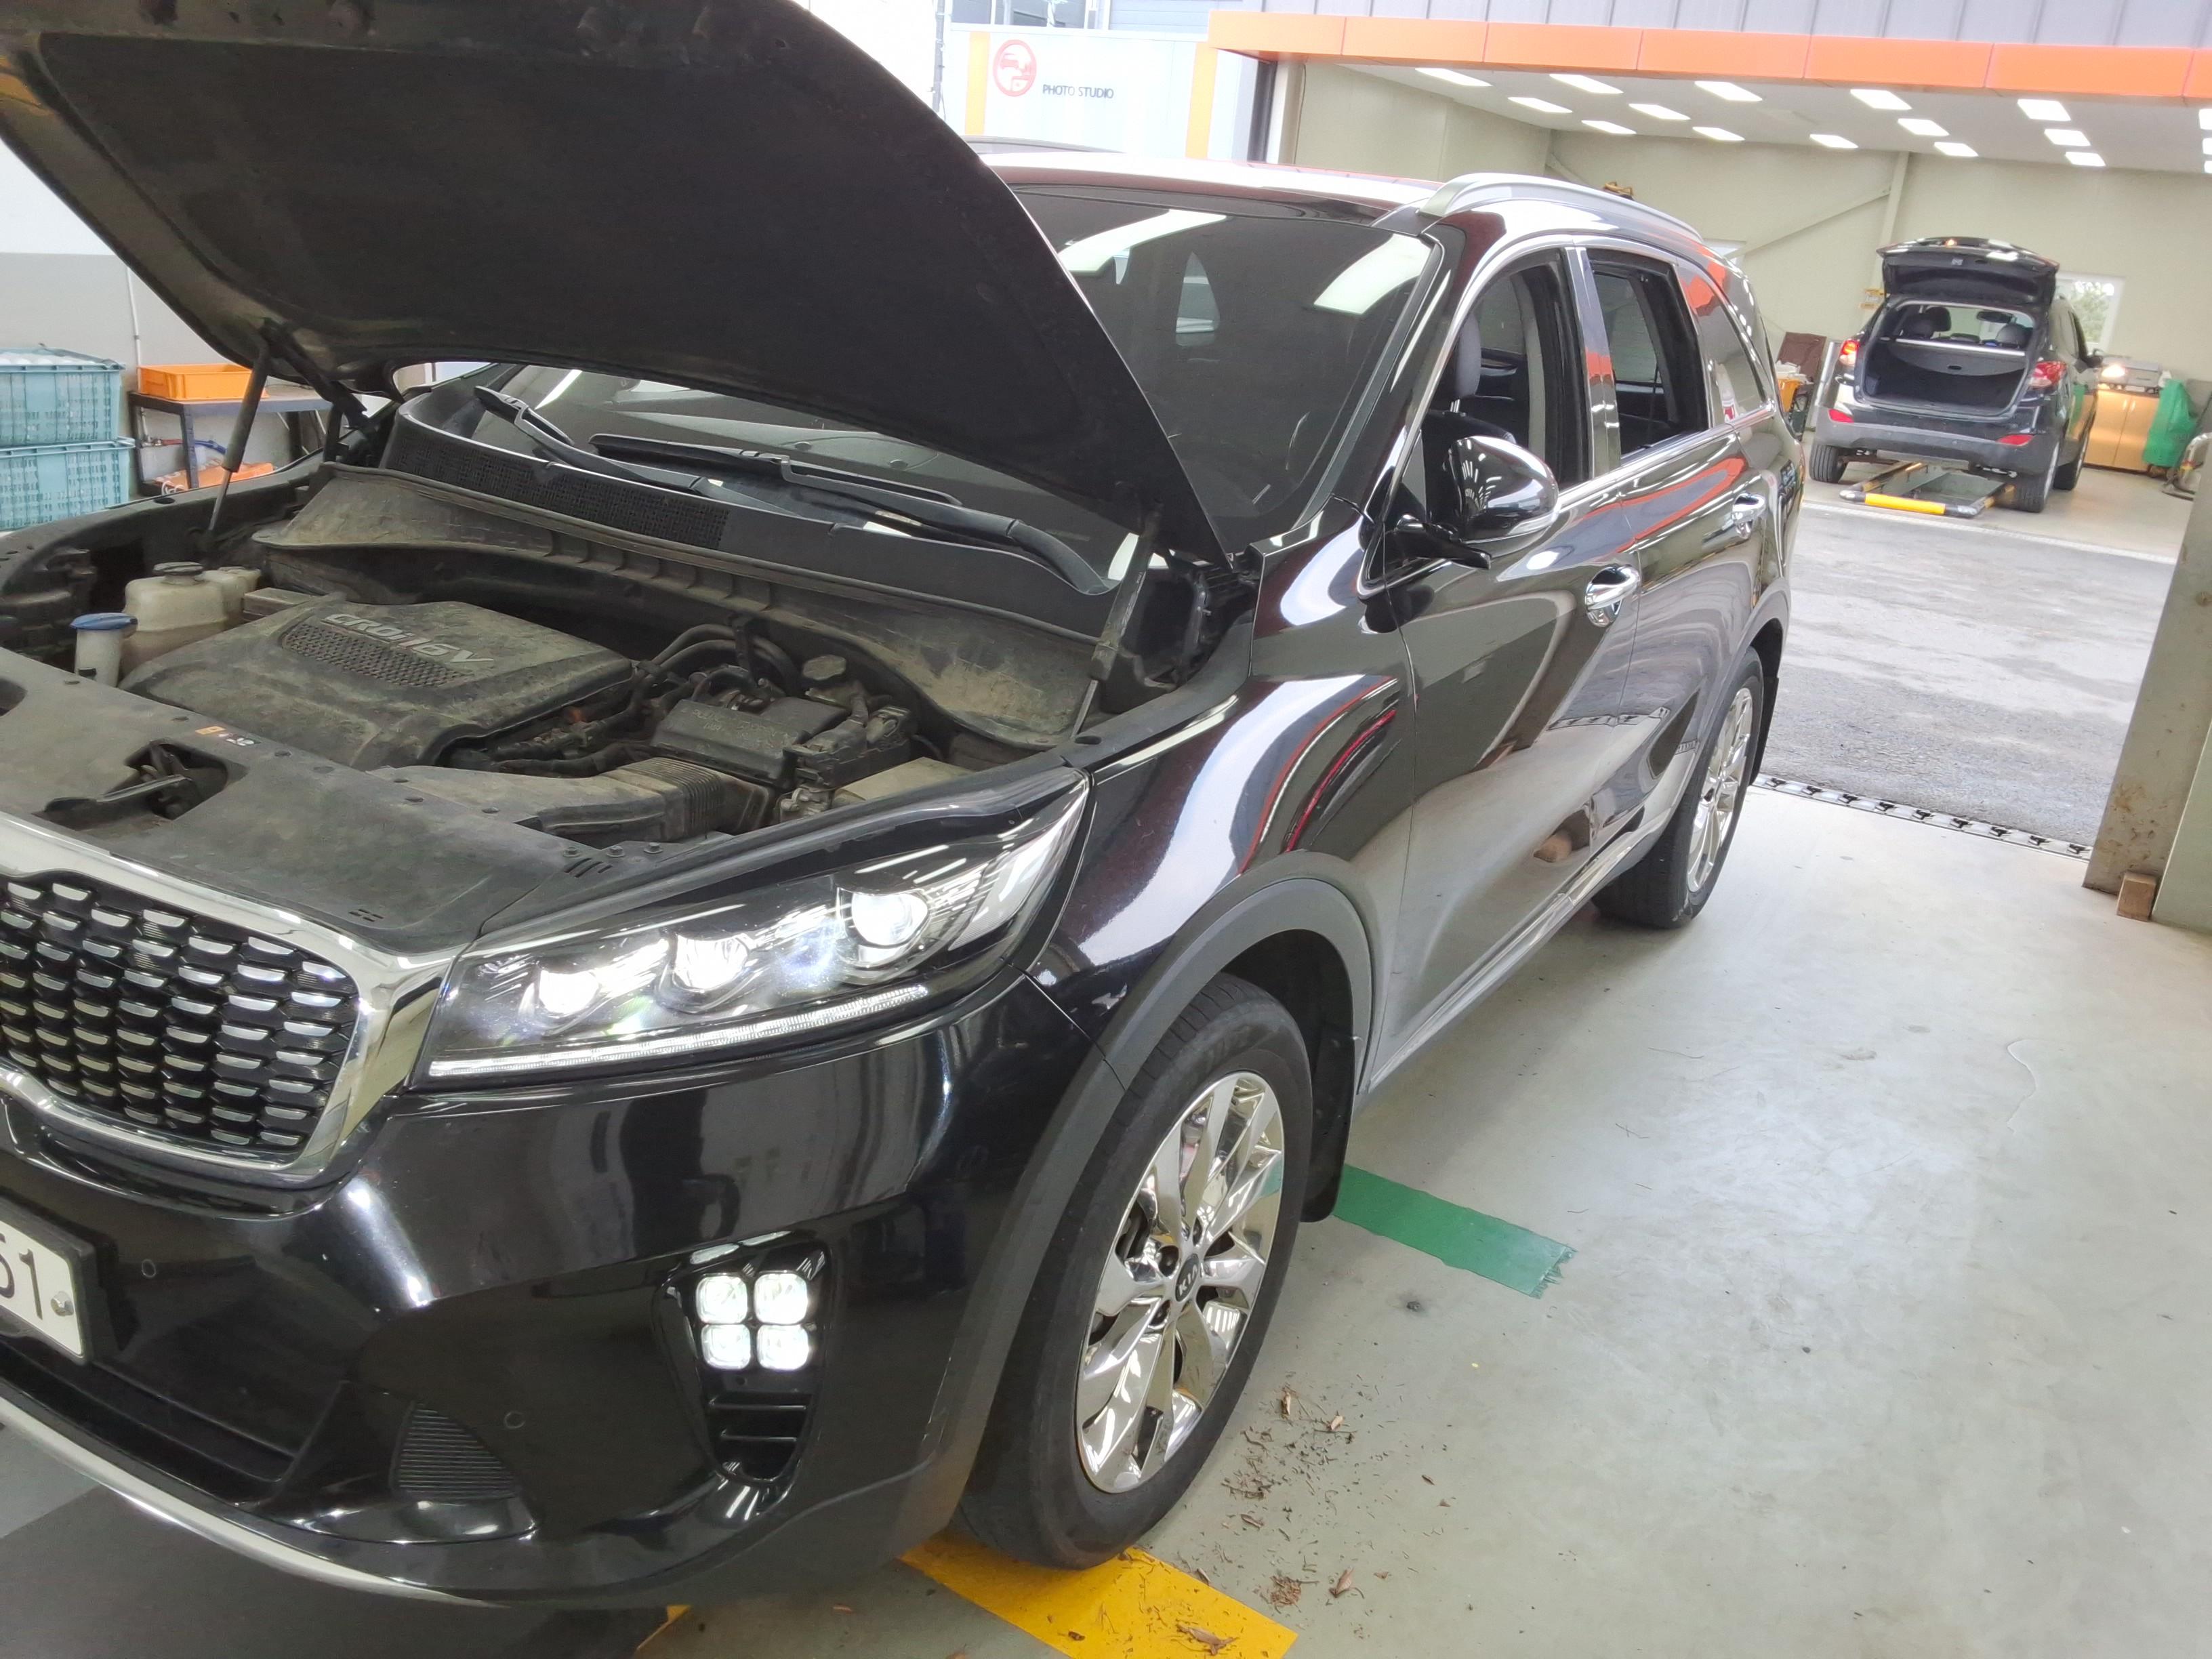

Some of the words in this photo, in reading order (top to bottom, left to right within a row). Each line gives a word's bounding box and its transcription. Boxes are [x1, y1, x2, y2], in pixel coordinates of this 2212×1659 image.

[1043, 84, 1075, 96] PHOTO
[1078, 86, 1114, 99] STUDIO
[1179, 1263, 1197, 1296] KIA
